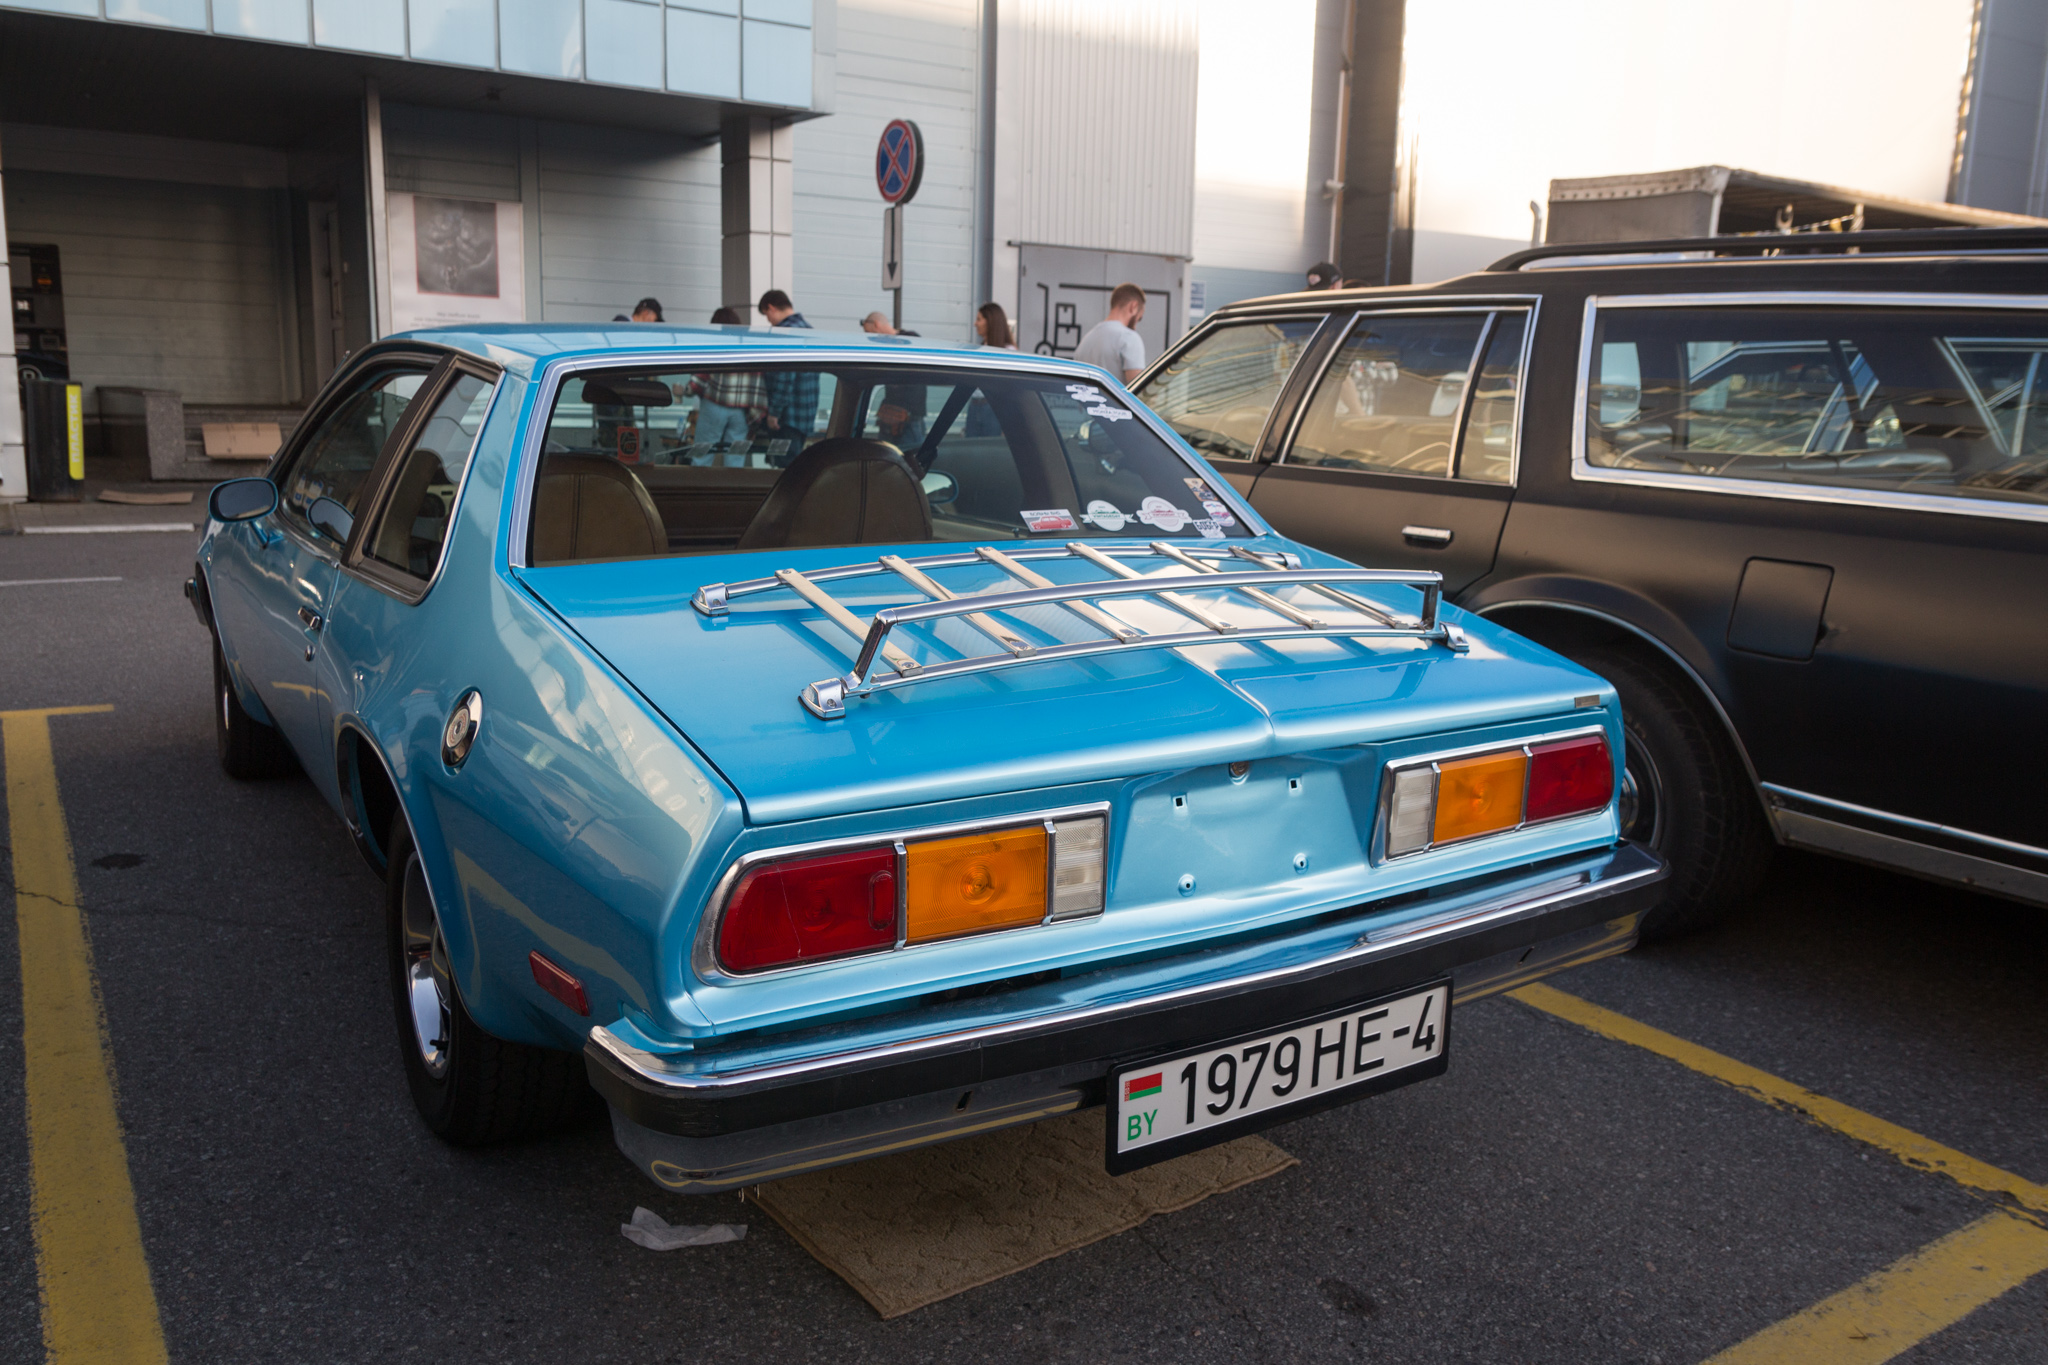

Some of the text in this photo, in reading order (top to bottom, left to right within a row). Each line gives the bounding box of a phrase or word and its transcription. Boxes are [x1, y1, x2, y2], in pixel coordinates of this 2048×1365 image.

[69, 394, 80, 463] ПЛАСТИК
[1181, 994, 1436, 1125] 1979HE-4
[1127, 1109, 1158, 1142] BY
